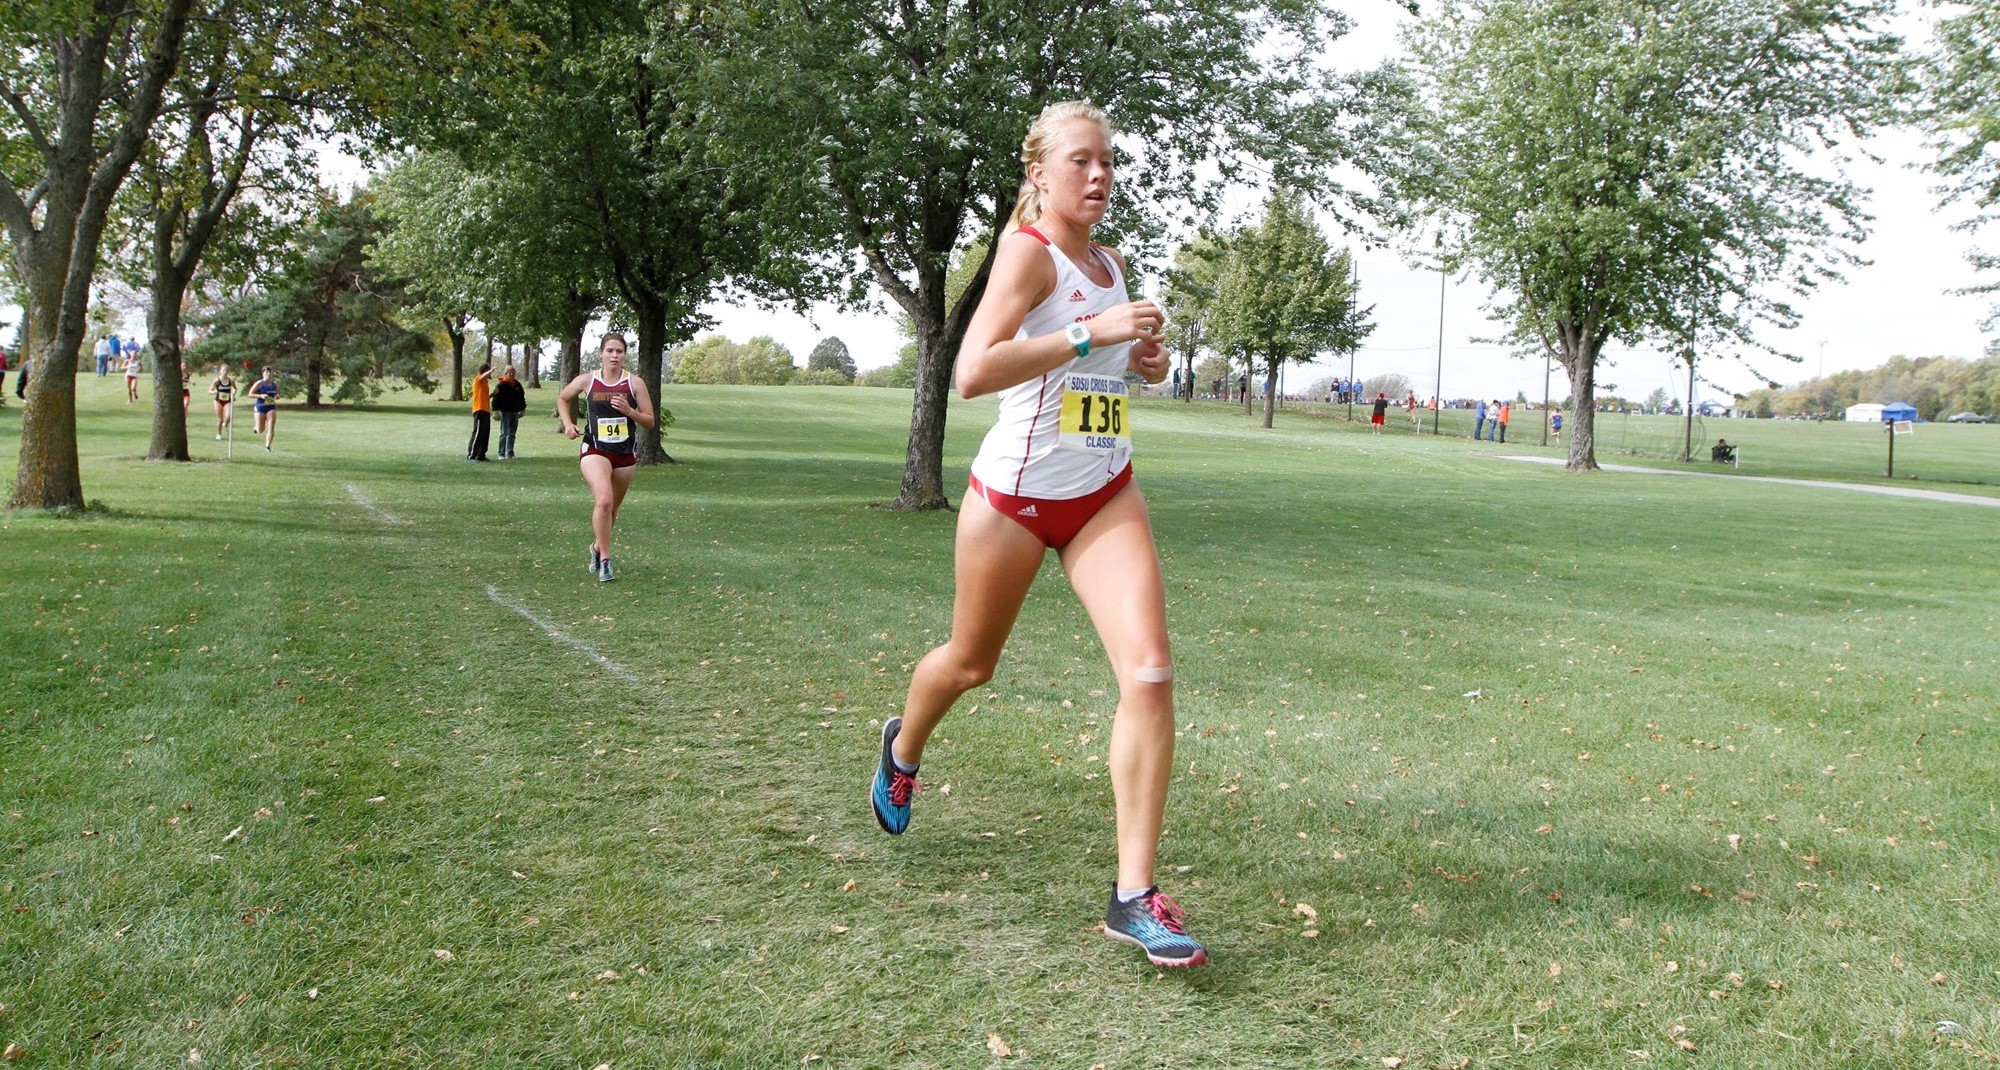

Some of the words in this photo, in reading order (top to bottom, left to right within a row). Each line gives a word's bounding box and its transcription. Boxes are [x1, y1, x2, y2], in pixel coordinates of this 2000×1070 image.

[1071, 377, 1089, 391] SDSU
[1091, 378, 1108, 393] CROSS
[1079, 395, 1121, 435] 136
[607, 424, 620, 436] 94
[1086, 436, 1117, 449] CLASSIC
